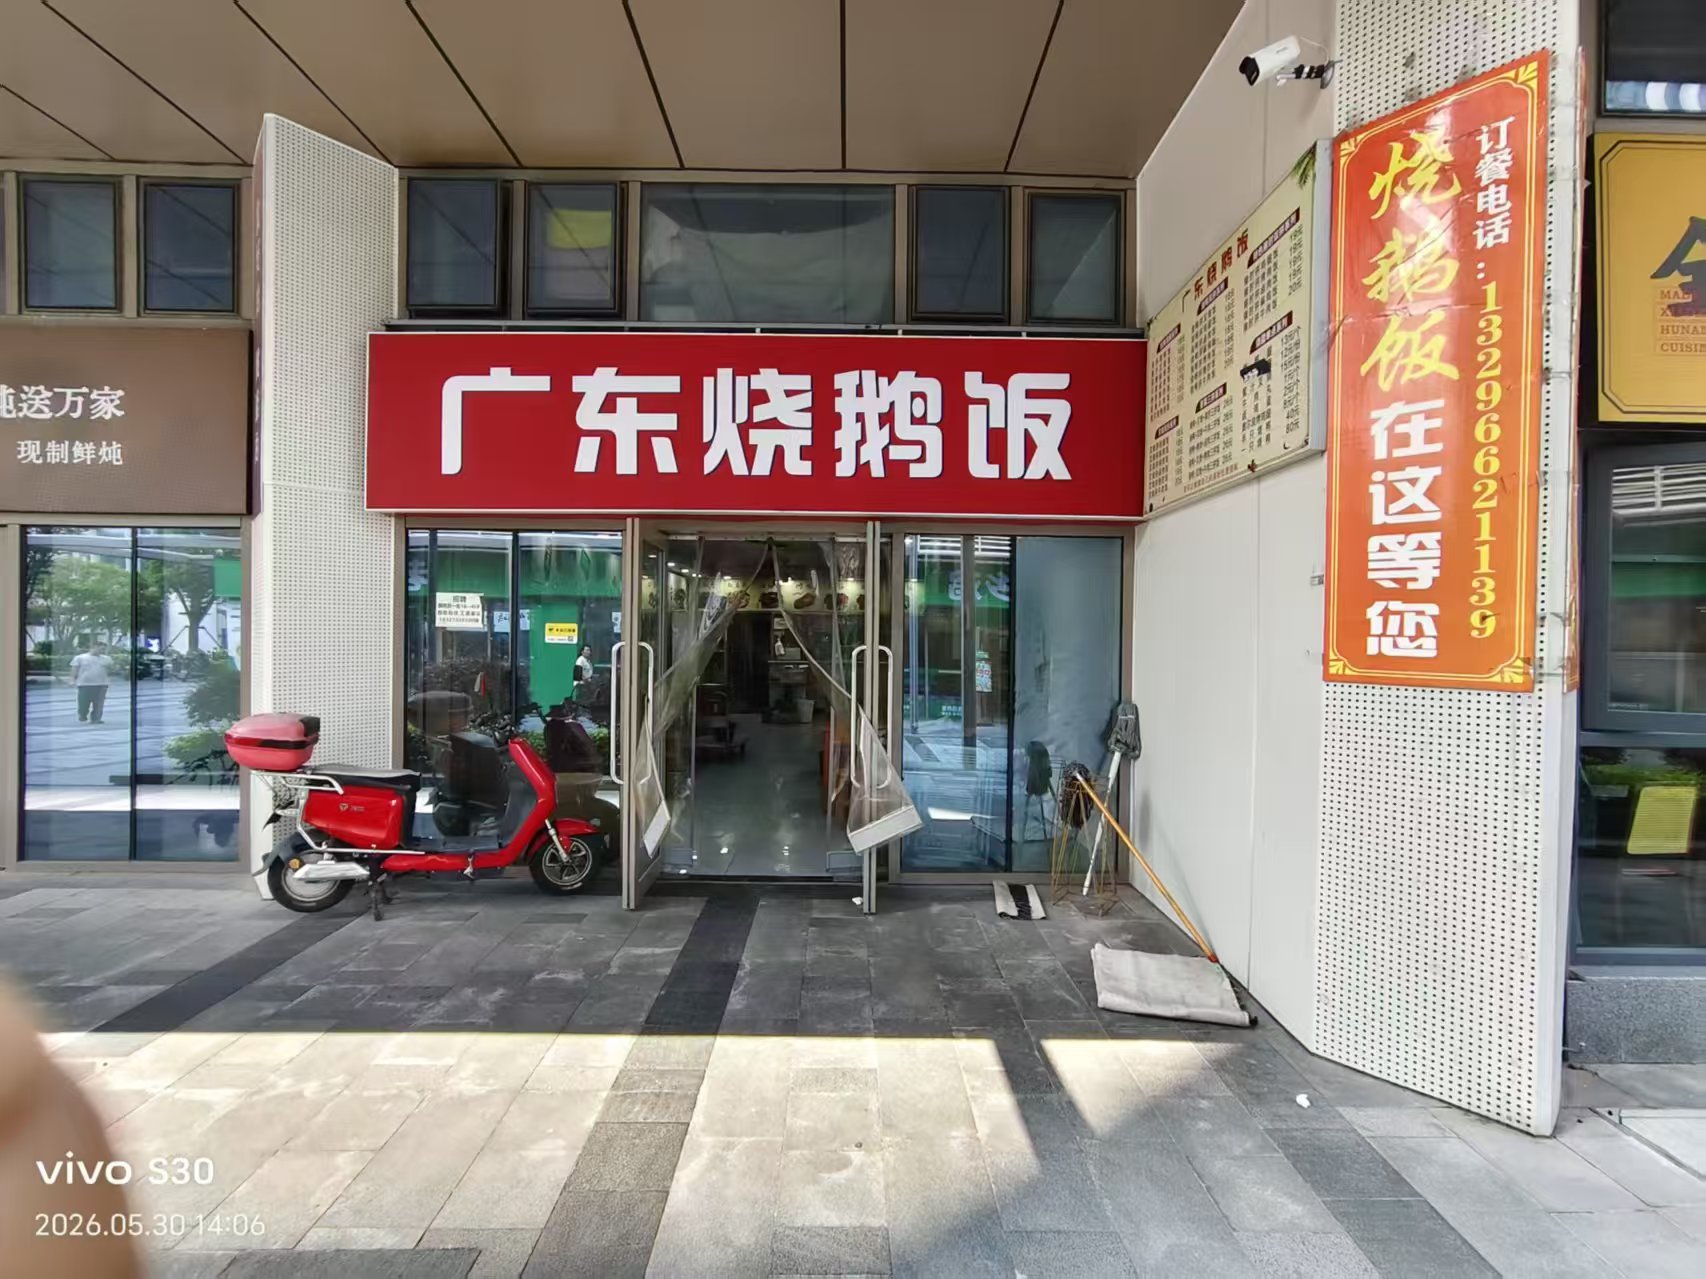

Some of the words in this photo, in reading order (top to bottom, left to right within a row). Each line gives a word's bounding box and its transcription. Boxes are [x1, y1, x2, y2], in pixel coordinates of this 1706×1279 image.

[441, 367, 1072, 479] 广东烧鹅饭
[1361, 132, 1462, 658] 烧鹅饭在这等您
[16, 440, 124, 466] 现制鲜炖
